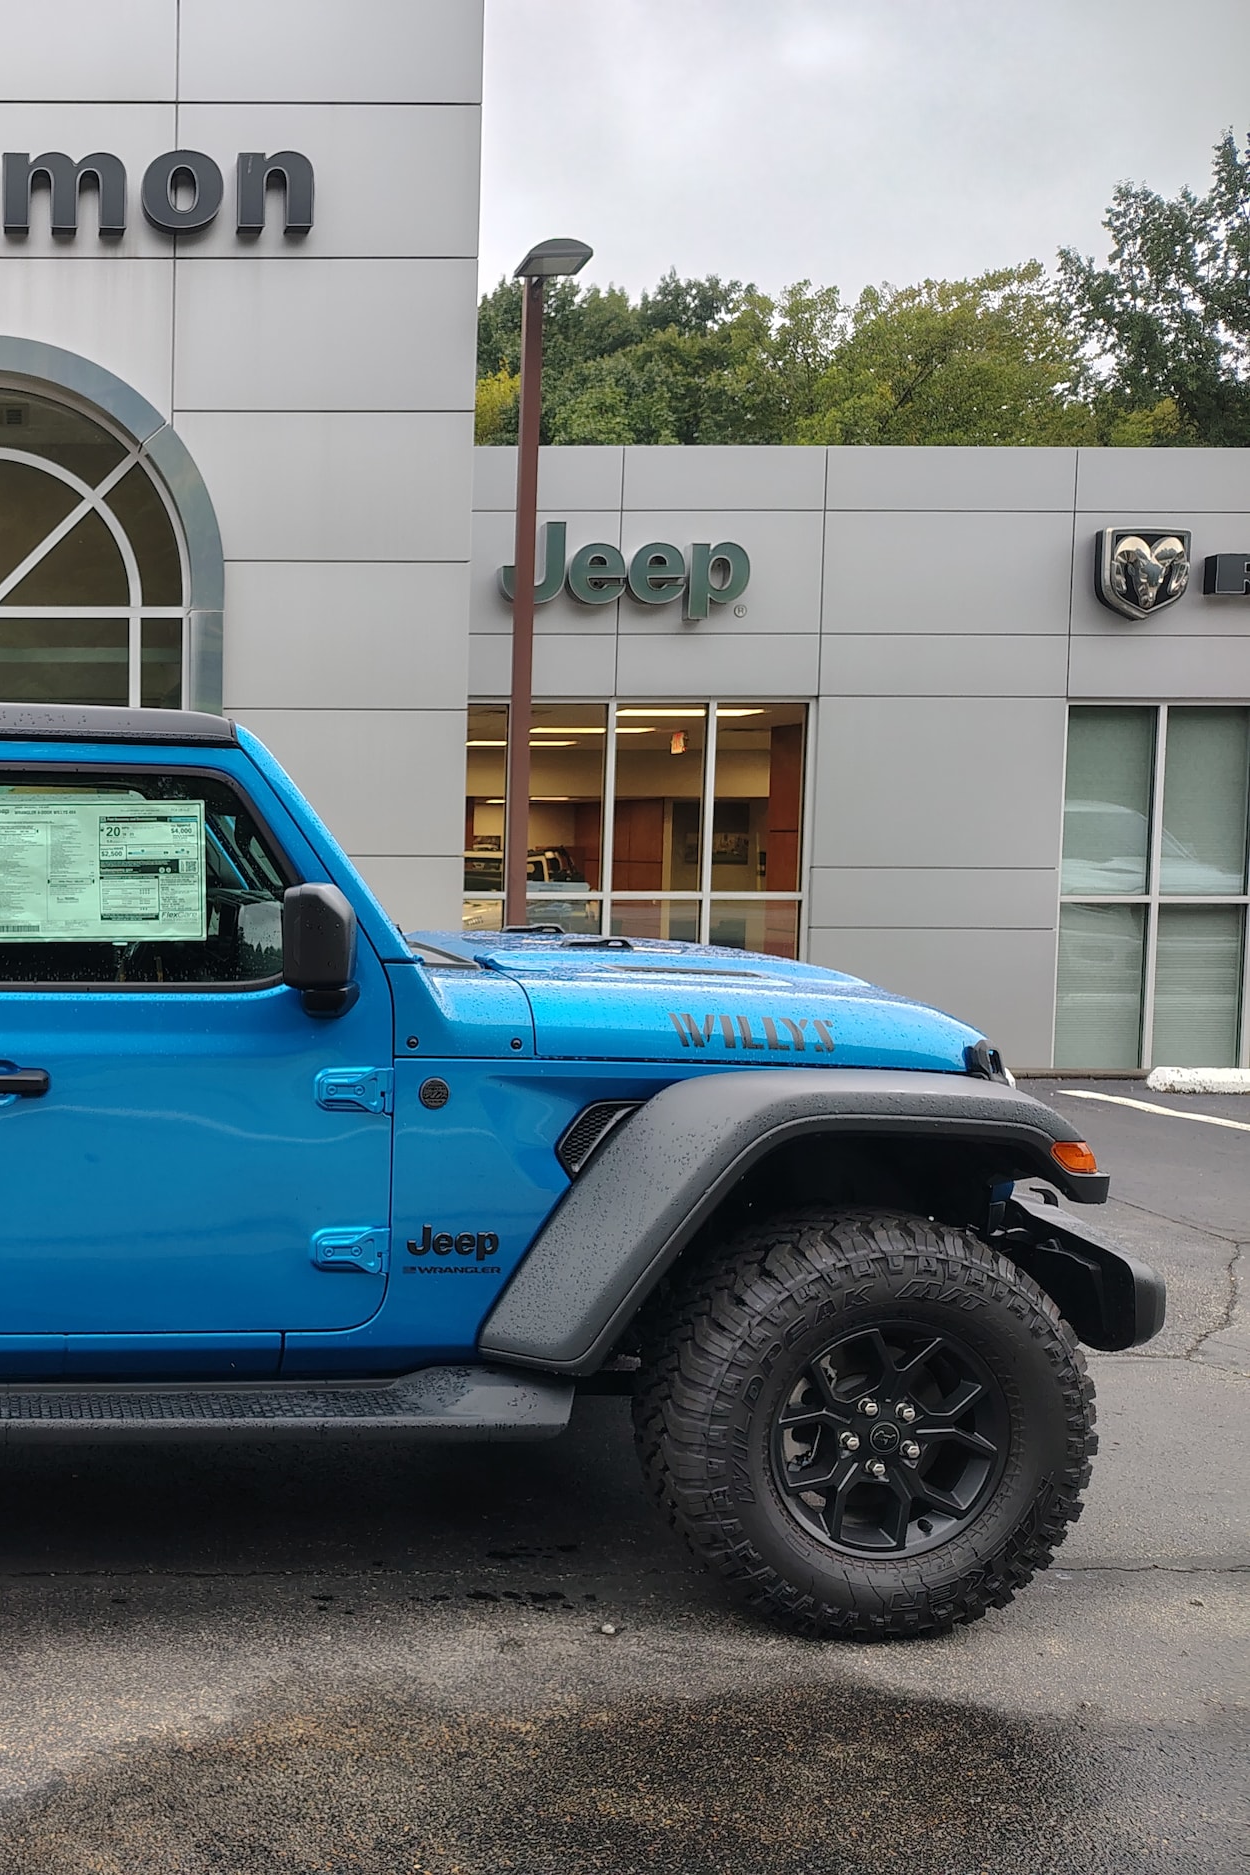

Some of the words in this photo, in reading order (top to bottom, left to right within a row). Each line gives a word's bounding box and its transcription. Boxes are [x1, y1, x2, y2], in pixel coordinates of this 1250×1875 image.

[499, 521, 751, 620] Jeep
[106, 826, 121, 837] 20
[669, 1013, 835, 1053] WILLYS
[407, 1224, 499, 1262] Jeep
[417, 1266, 501, 1274] WRANGLER
